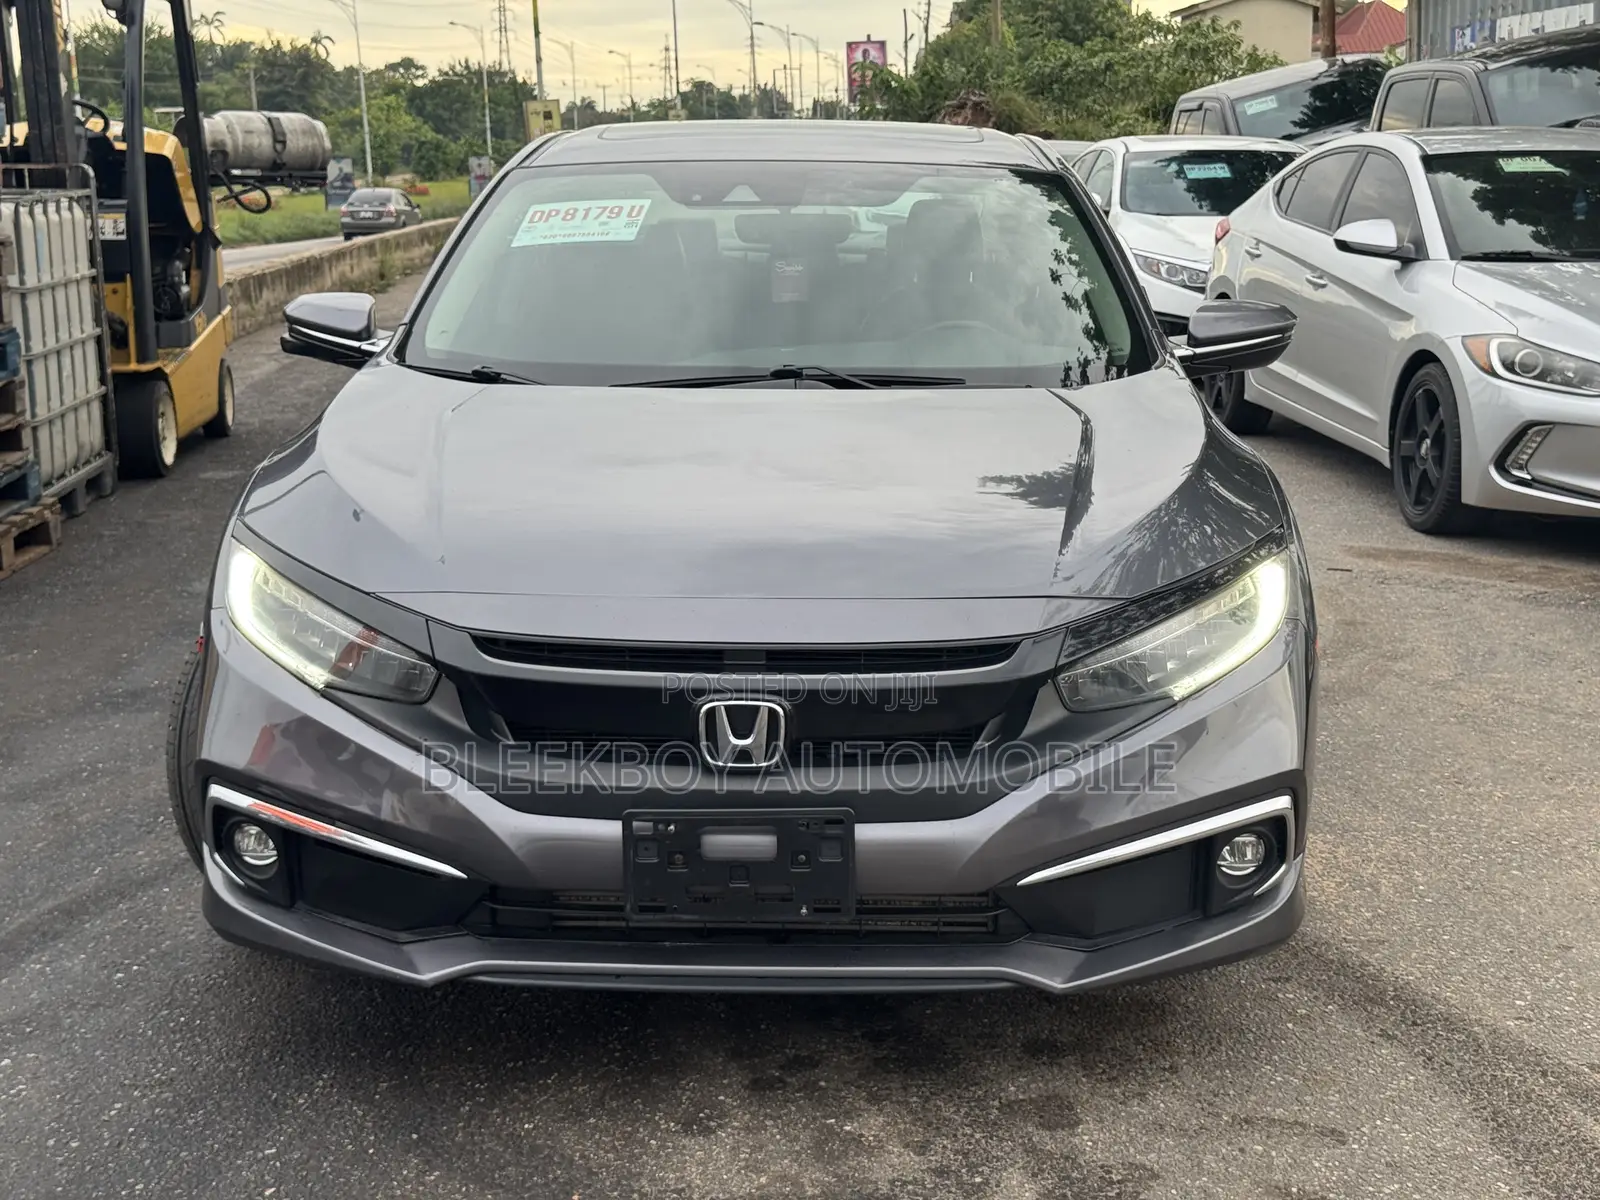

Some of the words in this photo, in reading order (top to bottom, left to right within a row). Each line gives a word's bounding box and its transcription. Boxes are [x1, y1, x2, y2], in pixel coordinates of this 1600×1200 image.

[527, 208, 561, 224] DP
[561, 205, 624, 222] 8179
[626, 204, 645, 219] U
